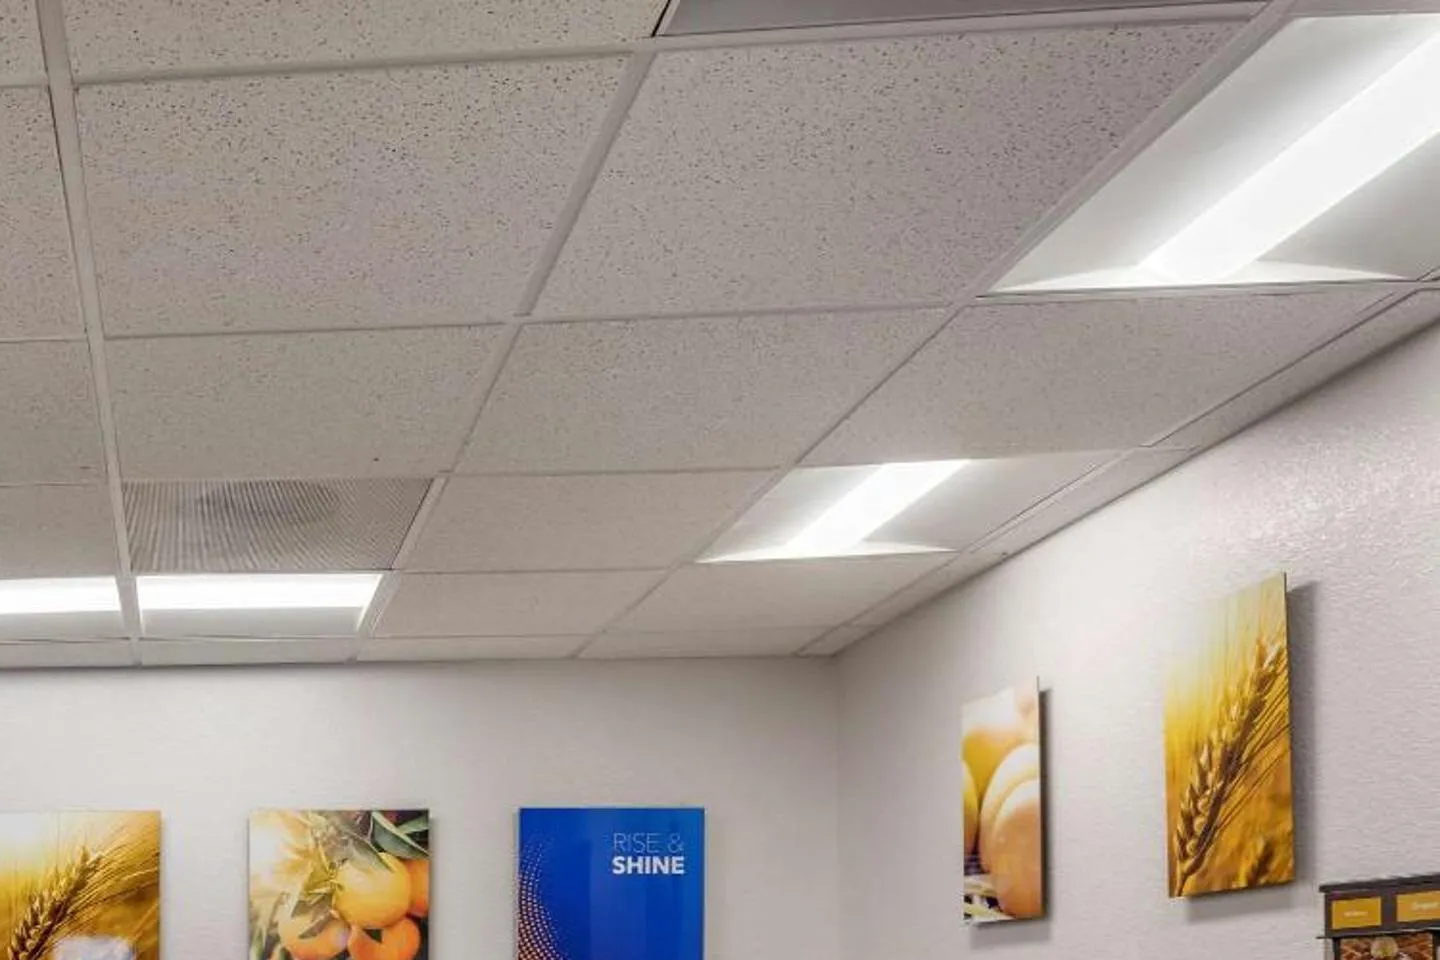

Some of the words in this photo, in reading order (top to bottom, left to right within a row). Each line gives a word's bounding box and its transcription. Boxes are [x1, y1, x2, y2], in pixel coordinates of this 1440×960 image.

[613, 832, 661, 853] RISE
[667, 832, 684, 853] &
[612, 855, 685, 875] SHINE
